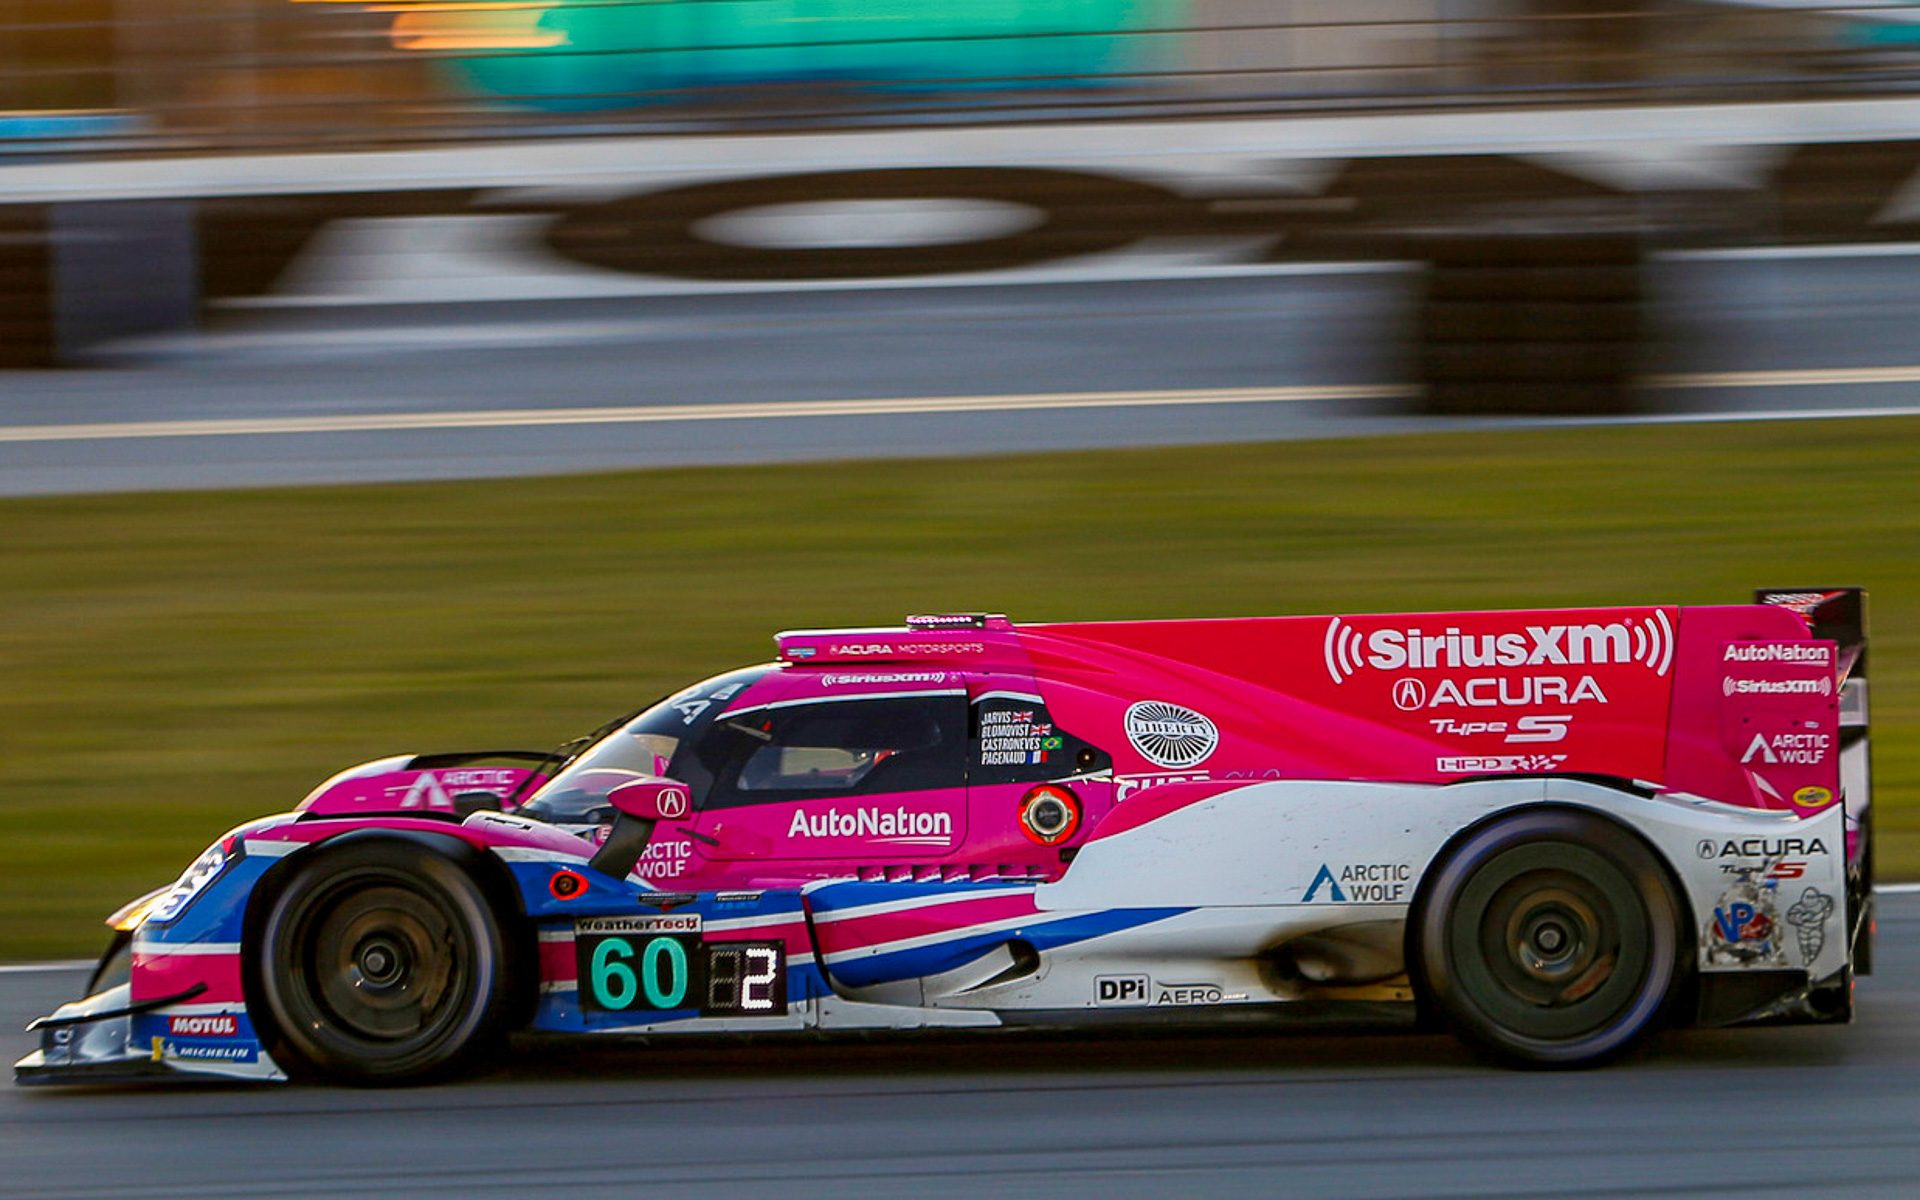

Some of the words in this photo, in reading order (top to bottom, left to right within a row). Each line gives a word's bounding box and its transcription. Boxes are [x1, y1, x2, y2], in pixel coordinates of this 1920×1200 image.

[838, 644, 893, 654] ACURA
[898, 643, 984, 654] MOTORSPORTS
[1723, 644, 1829, 661] AutoNation
[1428, 675, 1608, 708] ACURA
[981, 711, 1011, 726] JARVIS
[1132, 720, 1210, 735] LIBERTY
[1429, 718, 1508, 736] Type
[1504, 714, 1573, 743] S
[981, 737, 1040, 751] CASTRONEVES
[1772, 734, 1830, 748] ARCTIC
[981, 751, 1026, 765] PAGENAUD
[1440, 758, 1502, 770] HPD
[1779, 750, 1824, 764] WOLF
[788, 806, 952, 838] AutoNation
[640, 840, 692, 860] RCTIC
[1720, 839, 1828, 857] ACURA
[636, 860, 687, 878] WOLF
[1341, 864, 1411, 882] ARCTIC
[1764, 862, 1808, 878] S
[1350, 884, 1404, 902] WOLF
[579, 917, 698, 932] WeatherTech
[1714, 903, 1755, 943] VP
[591, 936, 688, 1010] 60
[741, 948, 777, 1010] 2
[1100, 980, 1145, 1001] DPi
[1157, 989, 1222, 1005] AERO
[173, 1017, 235, 1034] MOTUL
[180, 1048, 249, 1058] MICHELIN
